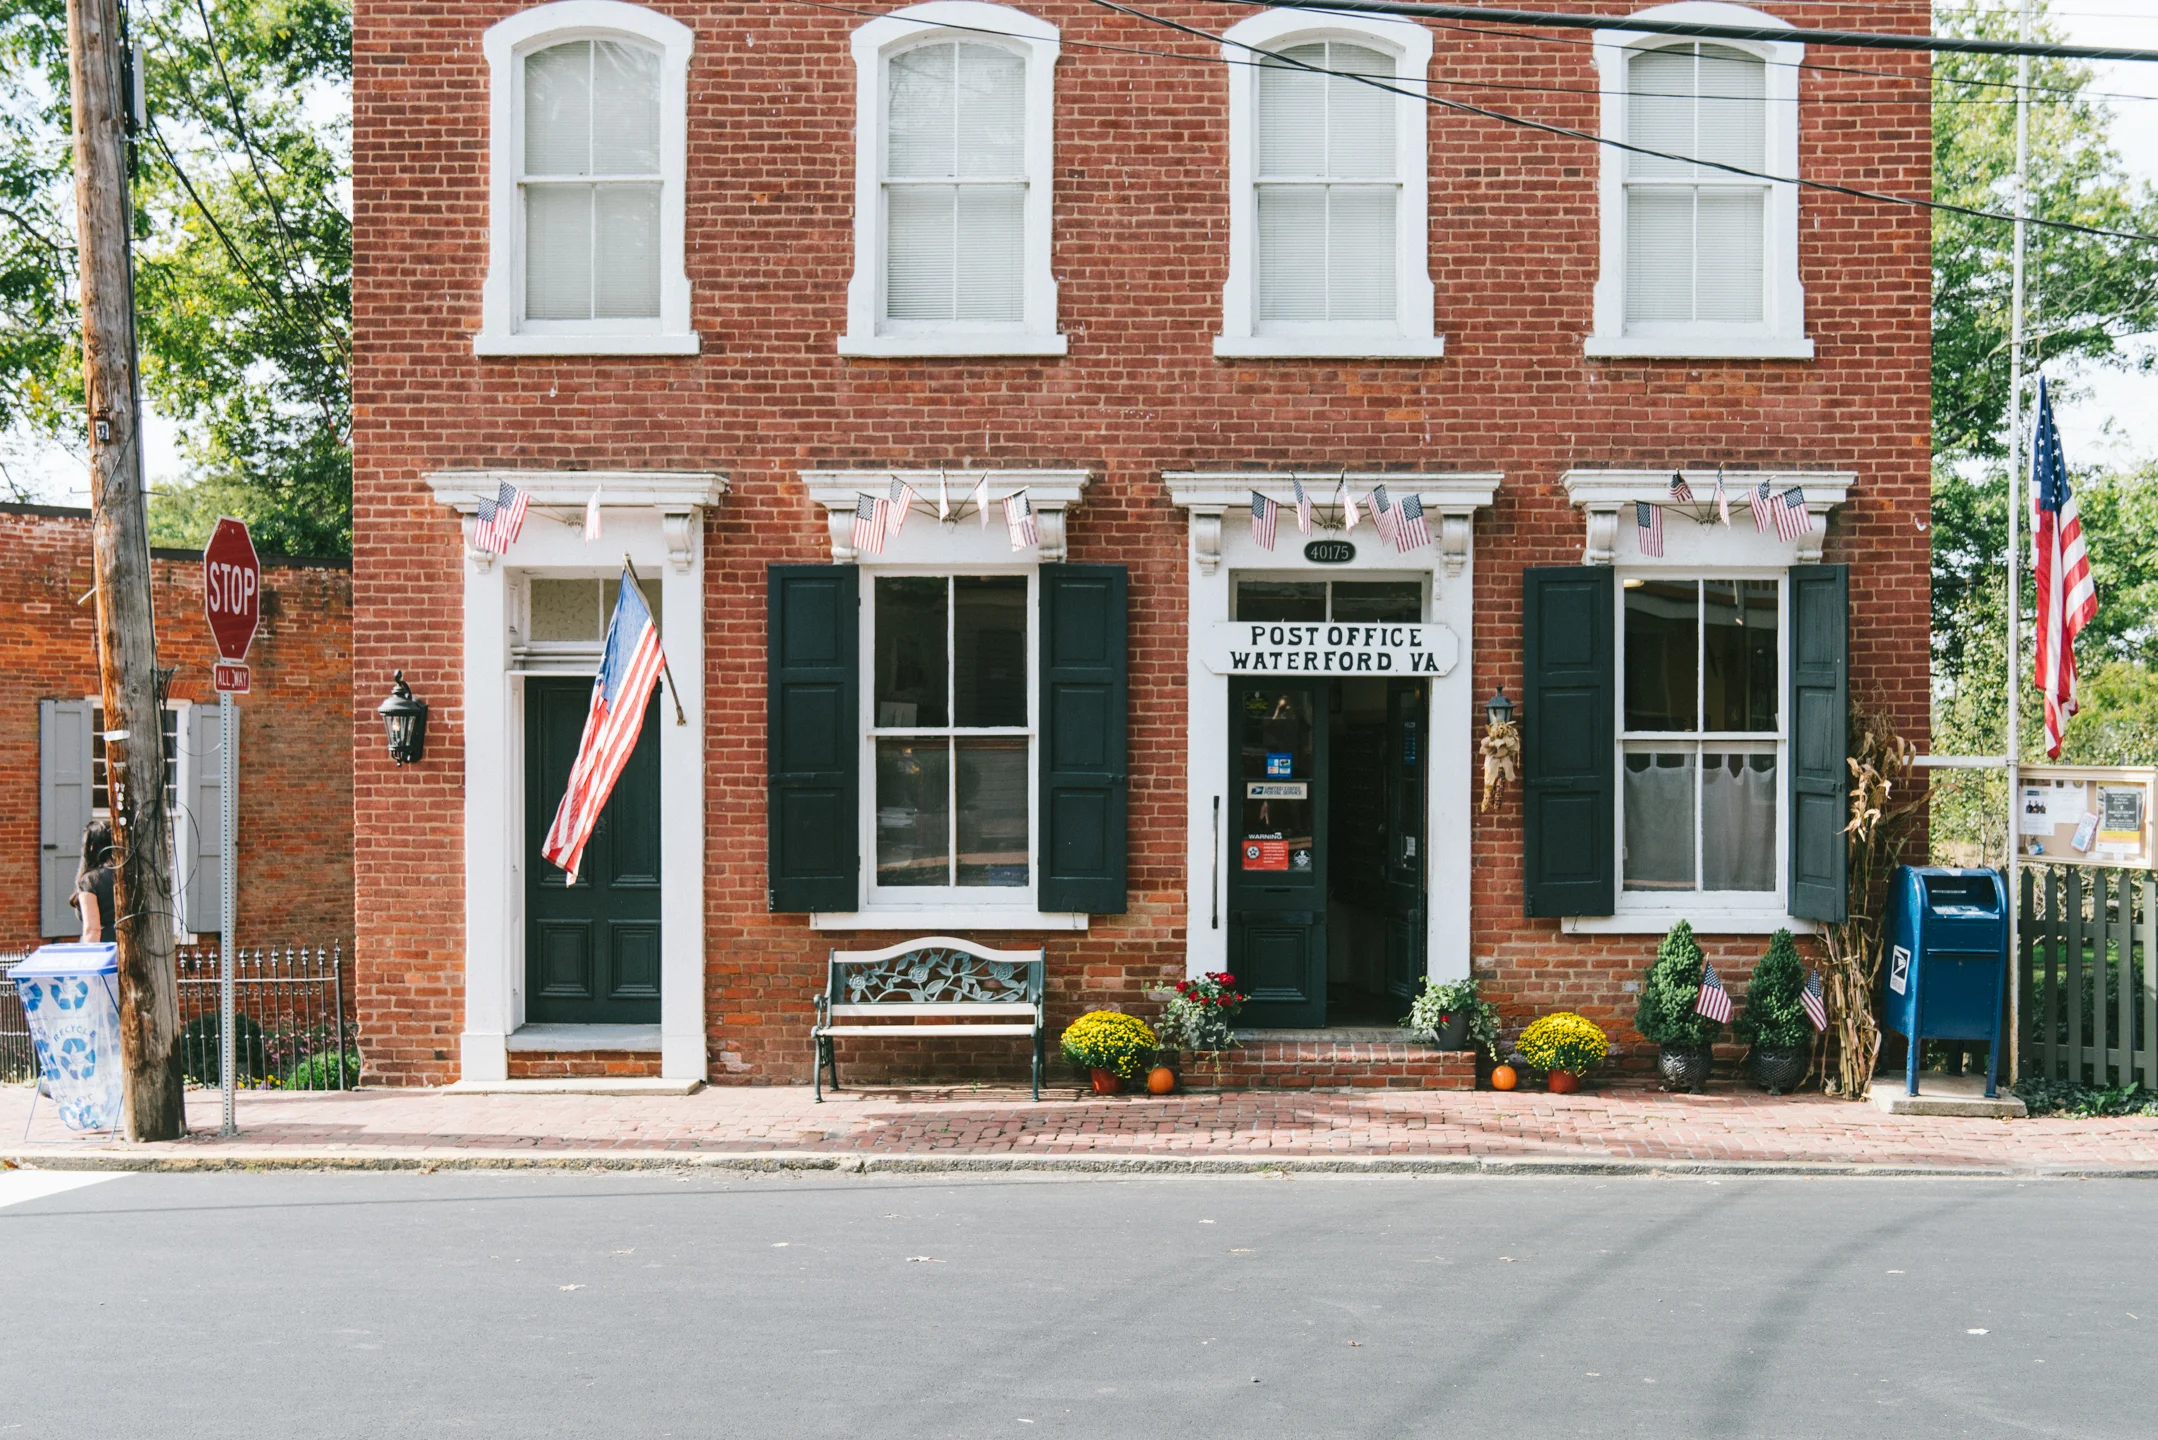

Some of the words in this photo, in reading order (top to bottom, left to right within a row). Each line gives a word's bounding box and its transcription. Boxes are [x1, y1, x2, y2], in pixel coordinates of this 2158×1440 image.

[1310, 545, 1349, 560] 40175
[210, 561, 255, 616] STOP
[1251, 626, 1319, 646] POST
[1327, 626, 1422, 647] OFFICE
[1411, 652, 1439, 672] VA
[218, 670, 231, 687] ALL
[233, 672, 248, 687] WAY
[53, 1024, 97, 1042] RECYCLE
